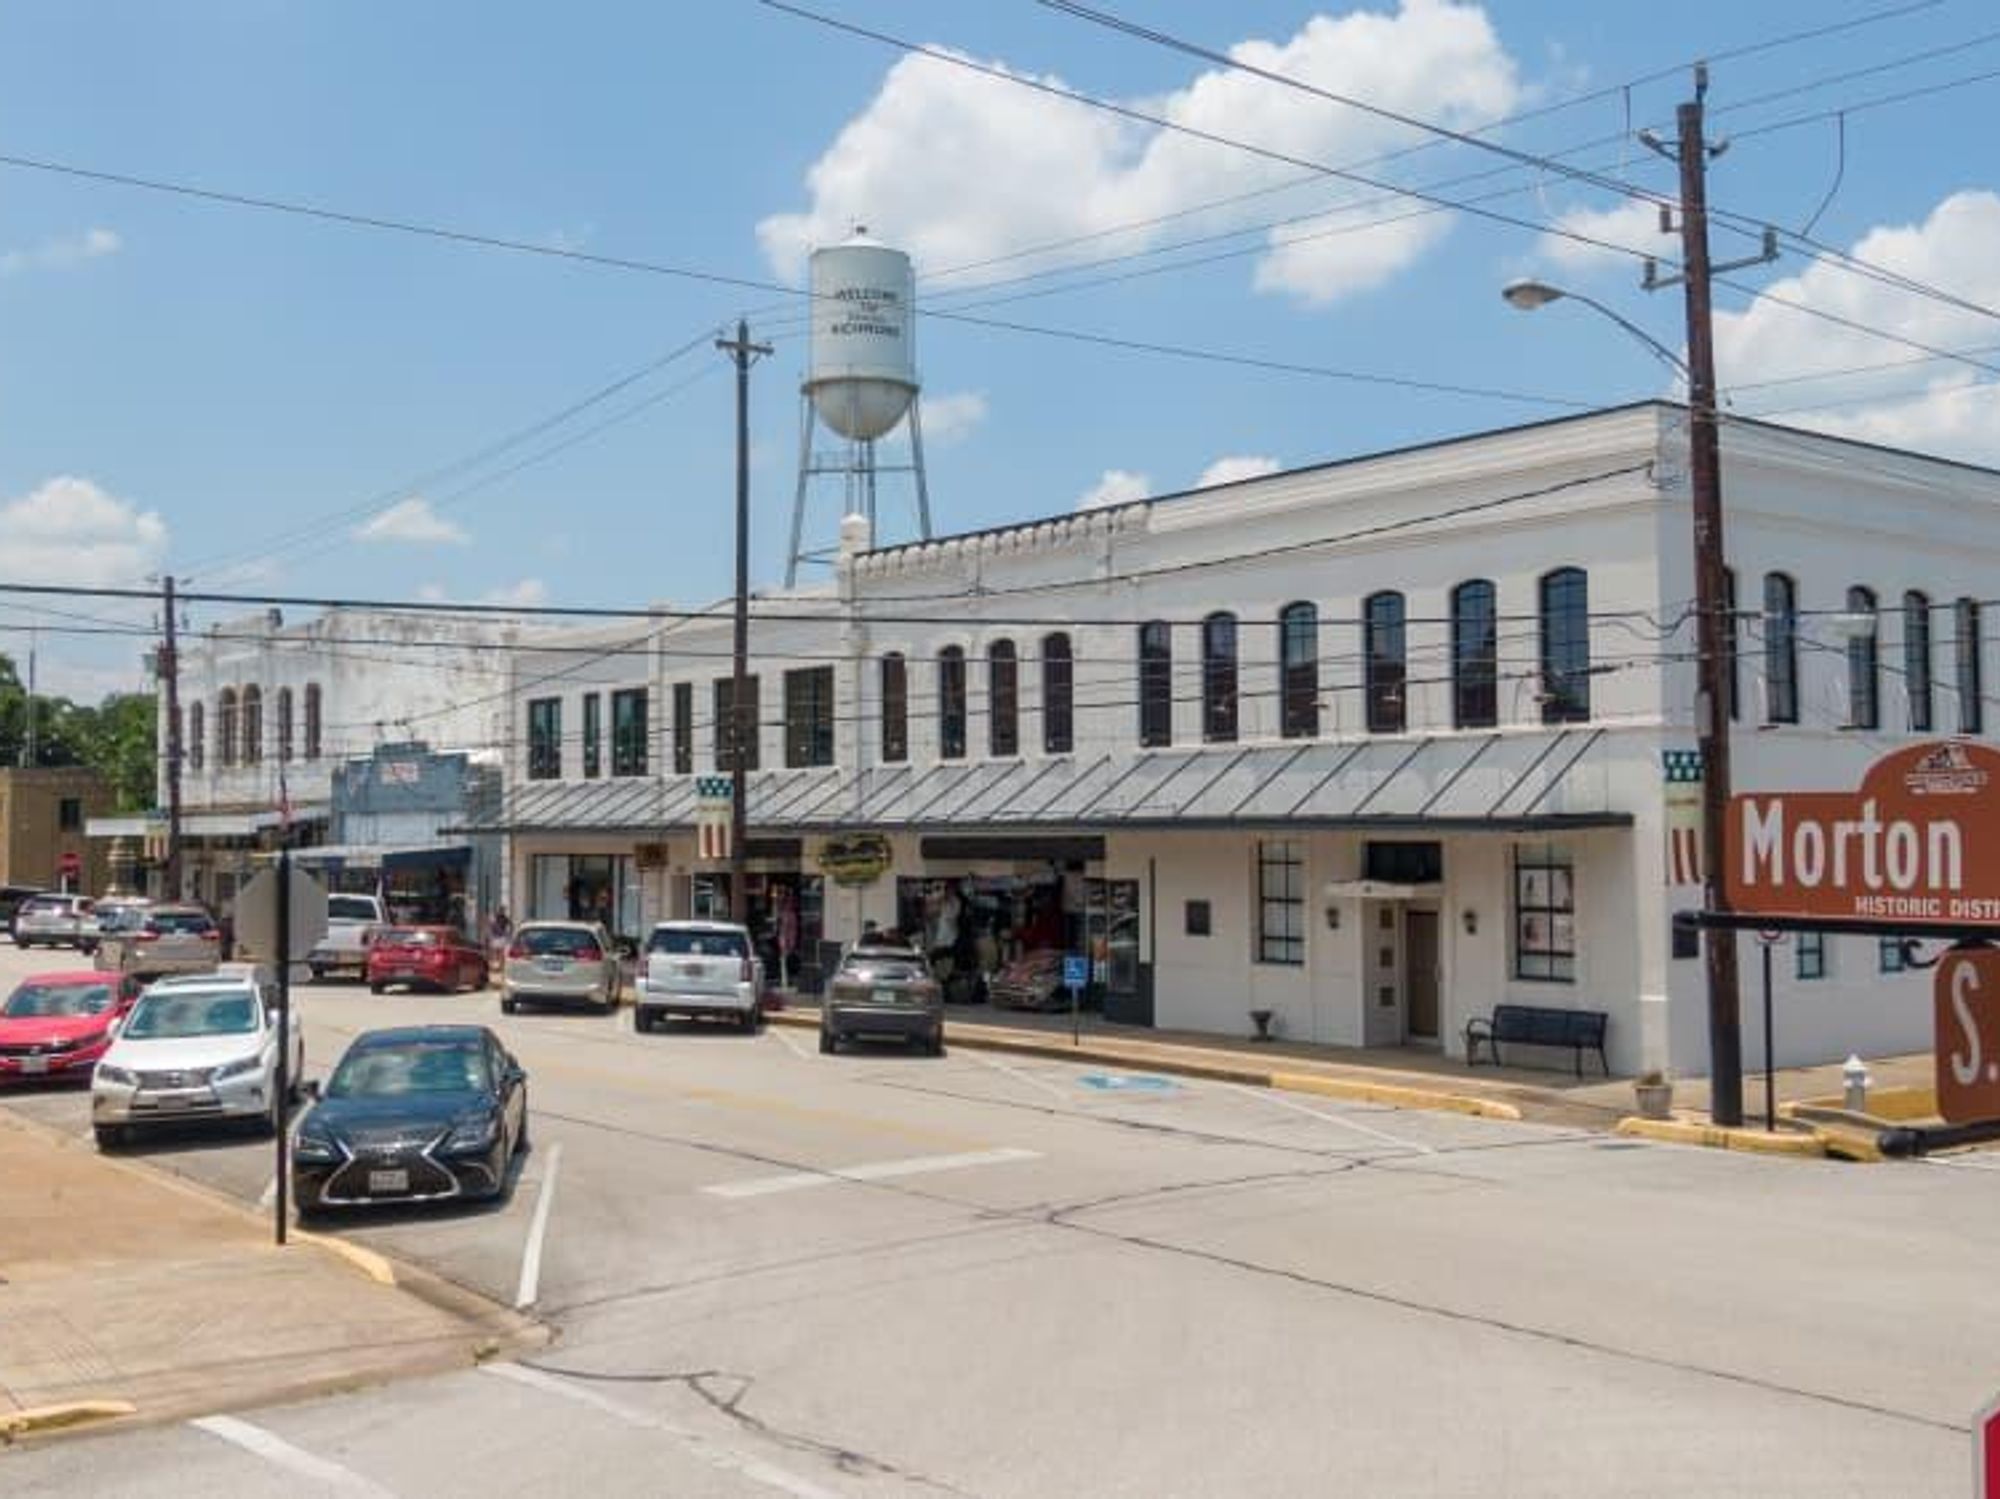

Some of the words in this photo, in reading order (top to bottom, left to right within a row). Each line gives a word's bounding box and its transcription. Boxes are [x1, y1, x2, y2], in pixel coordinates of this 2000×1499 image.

[1741, 799, 1962, 890] Morton
[1855, 895, 1941, 917] HISTORIC
[1951, 960, 1998, 1085] S.
